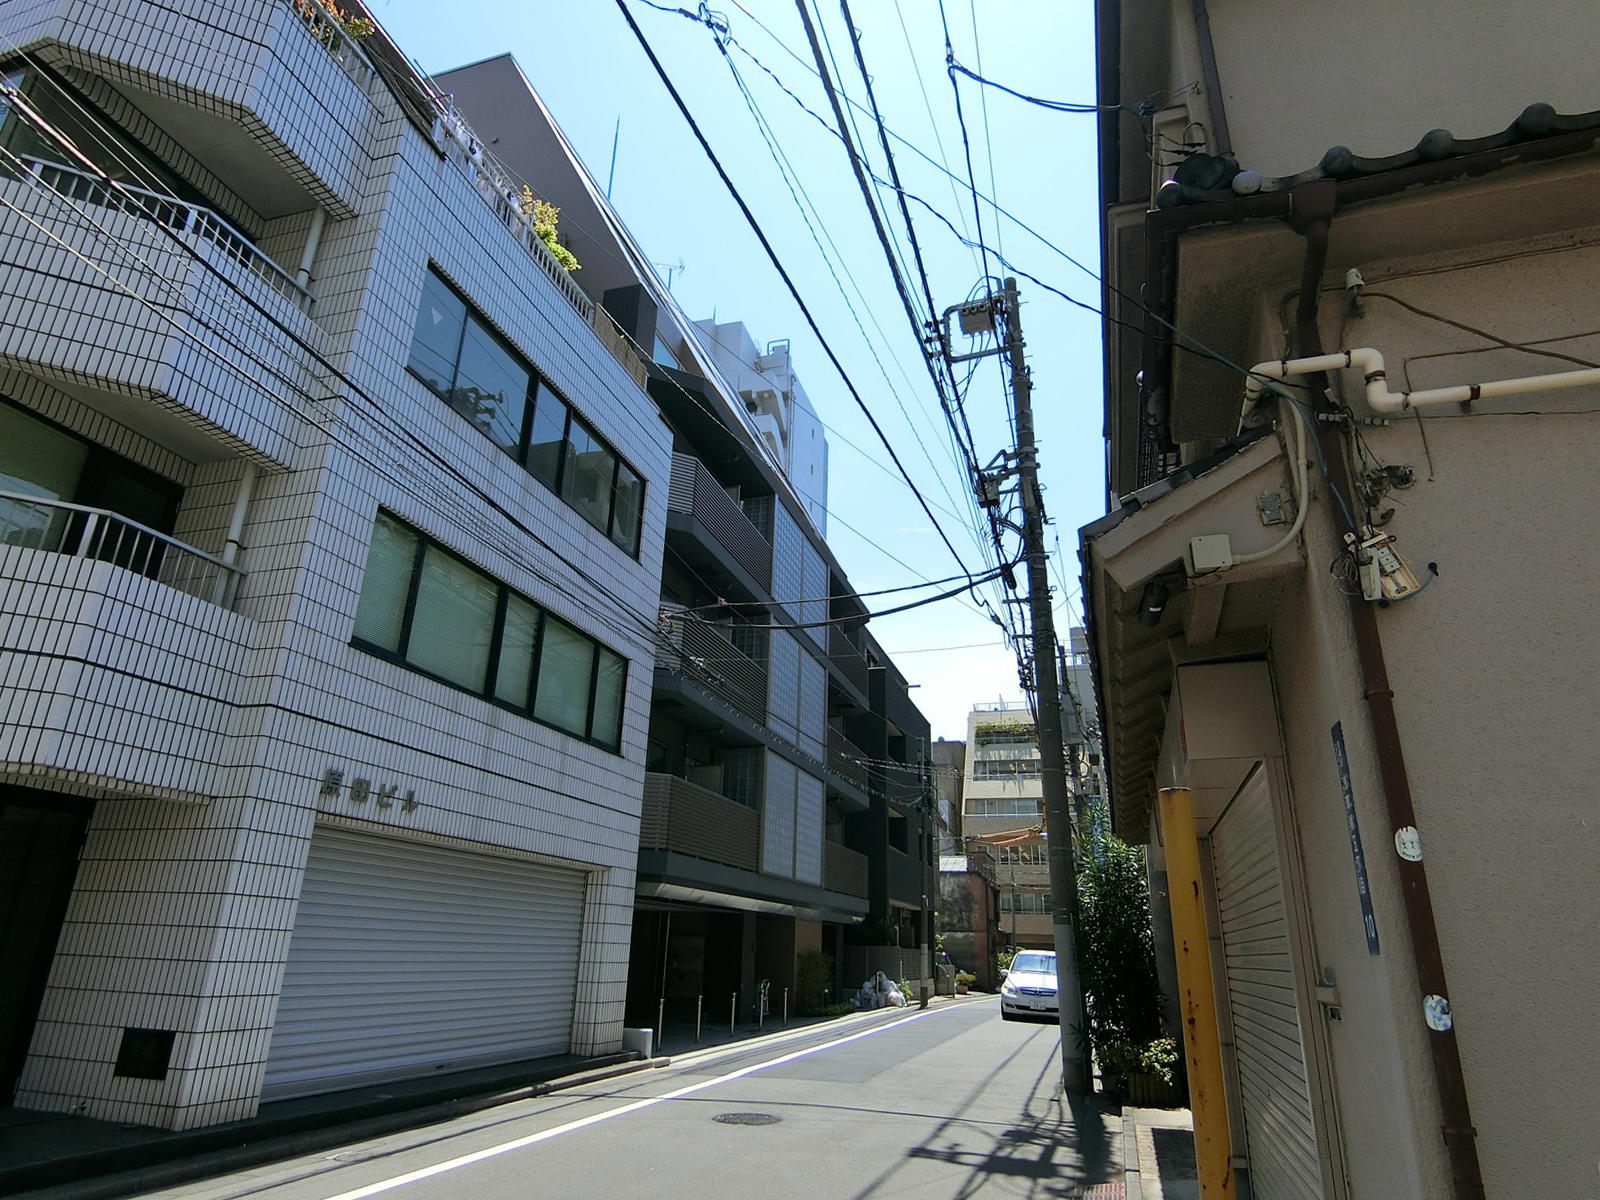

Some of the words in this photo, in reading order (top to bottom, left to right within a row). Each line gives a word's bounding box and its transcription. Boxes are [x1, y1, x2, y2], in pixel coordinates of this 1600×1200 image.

[319, 769, 420, 813] 原田ビル
[1364, 914, 1376, 938] 10
